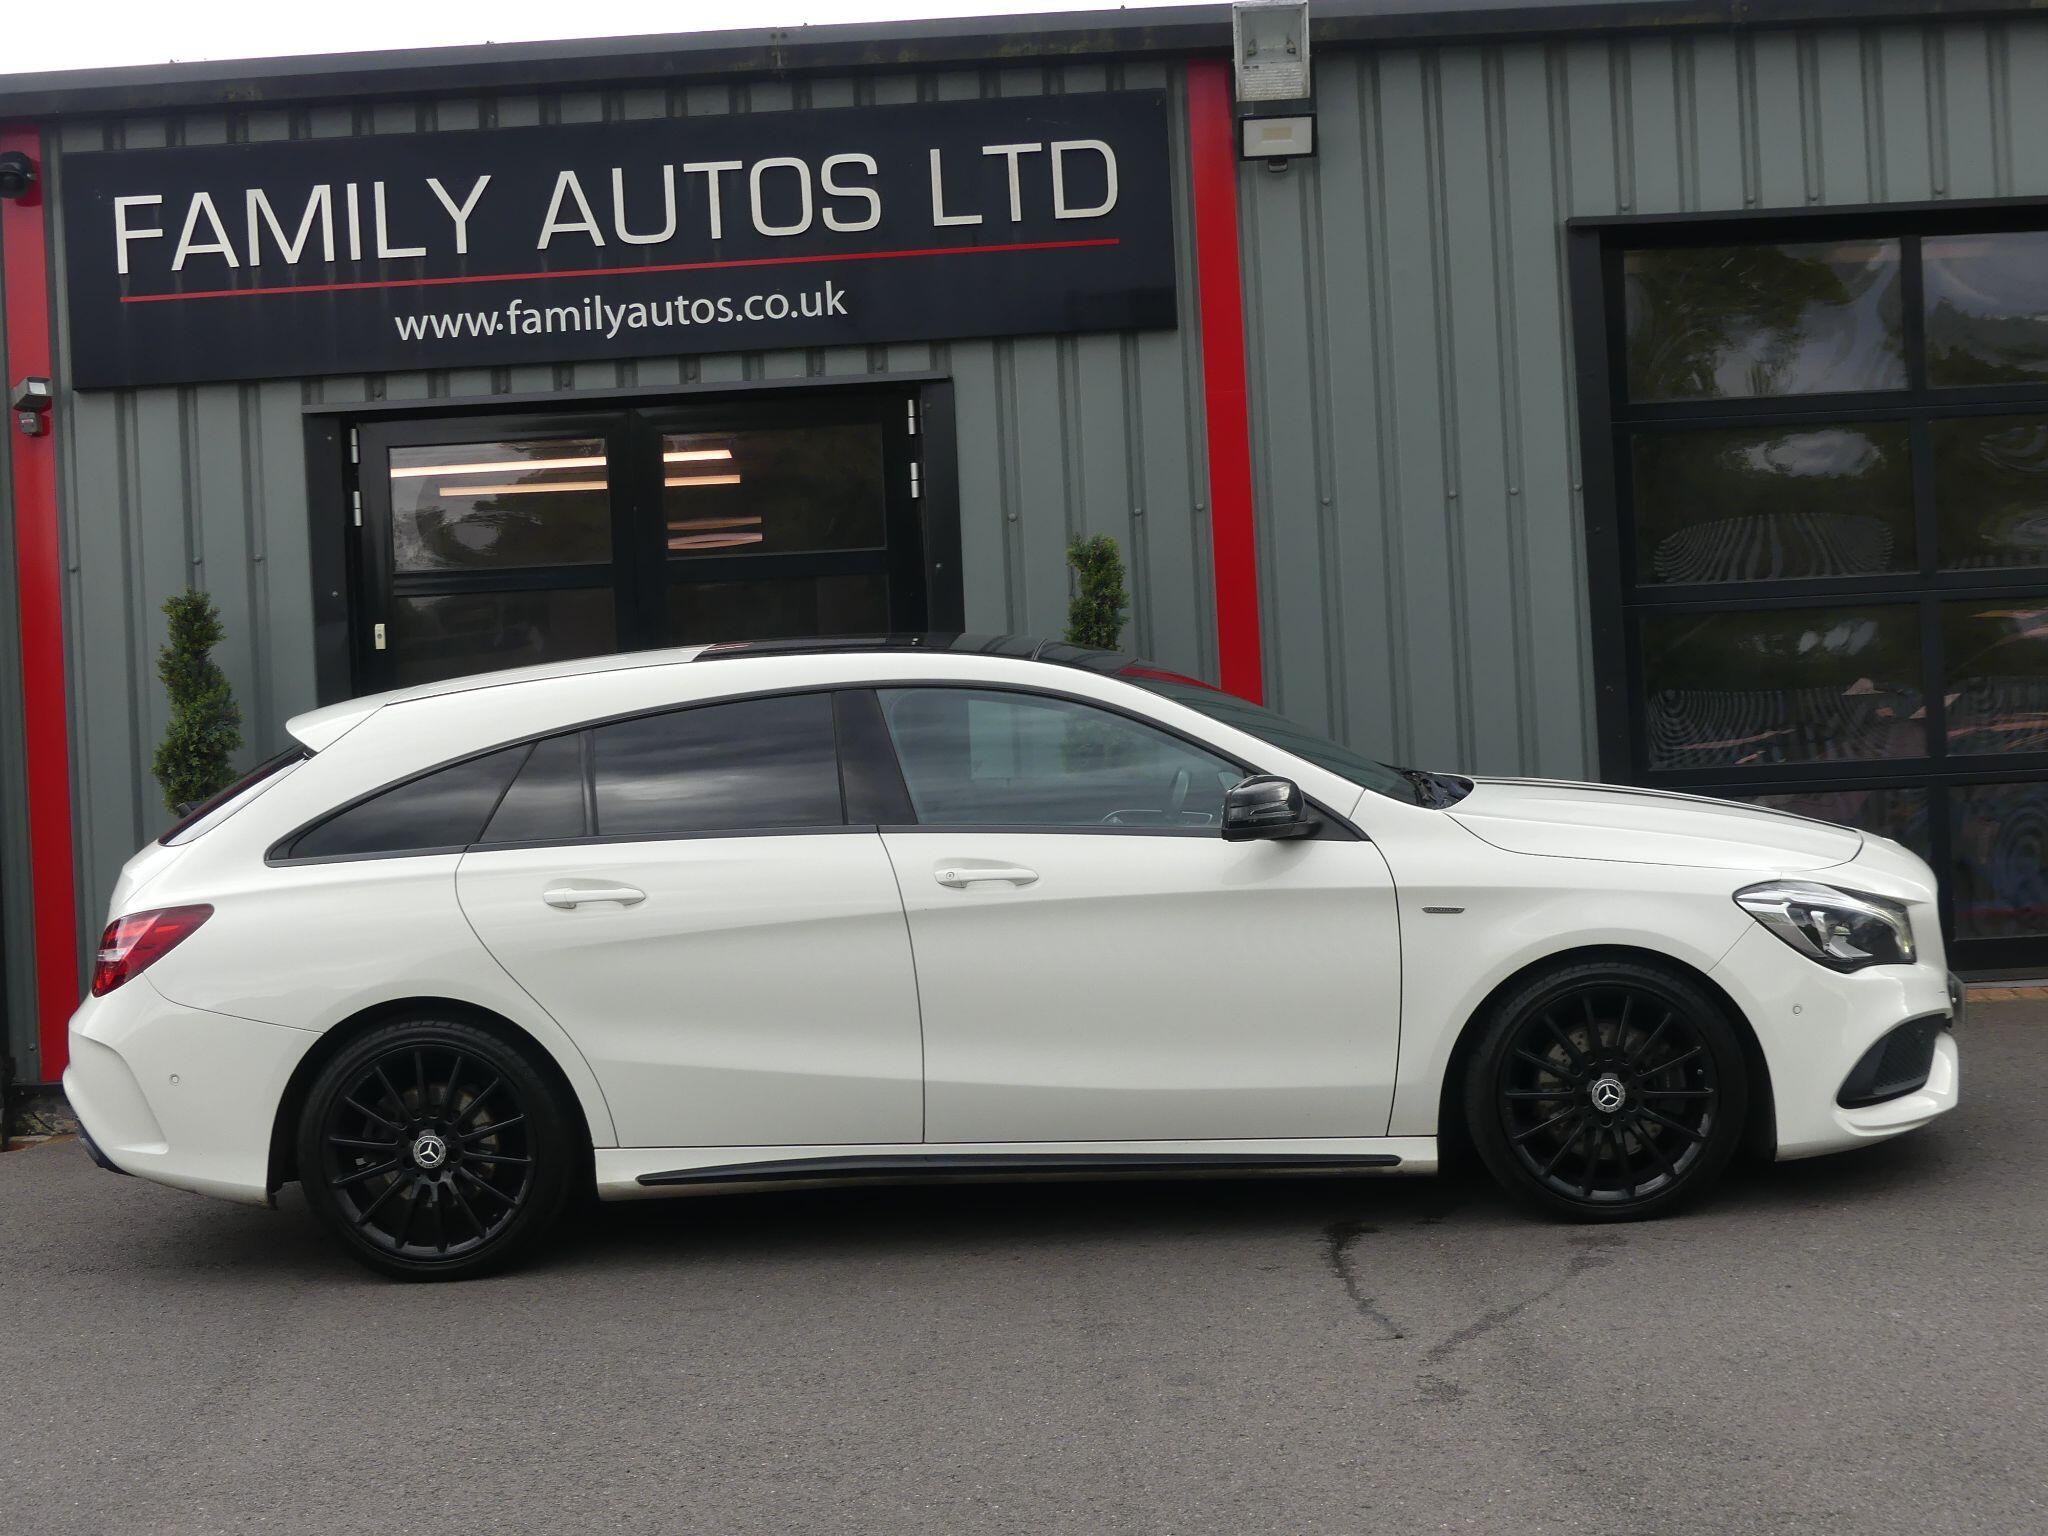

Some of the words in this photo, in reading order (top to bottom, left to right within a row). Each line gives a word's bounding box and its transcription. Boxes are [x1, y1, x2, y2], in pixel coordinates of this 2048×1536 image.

[113, 174, 492, 275] FAMILY
[536, 153, 881, 250] AUTOS
[929, 139, 1118, 227] LTD
[394, 280, 848, 341] www.familyautos.co.uk
